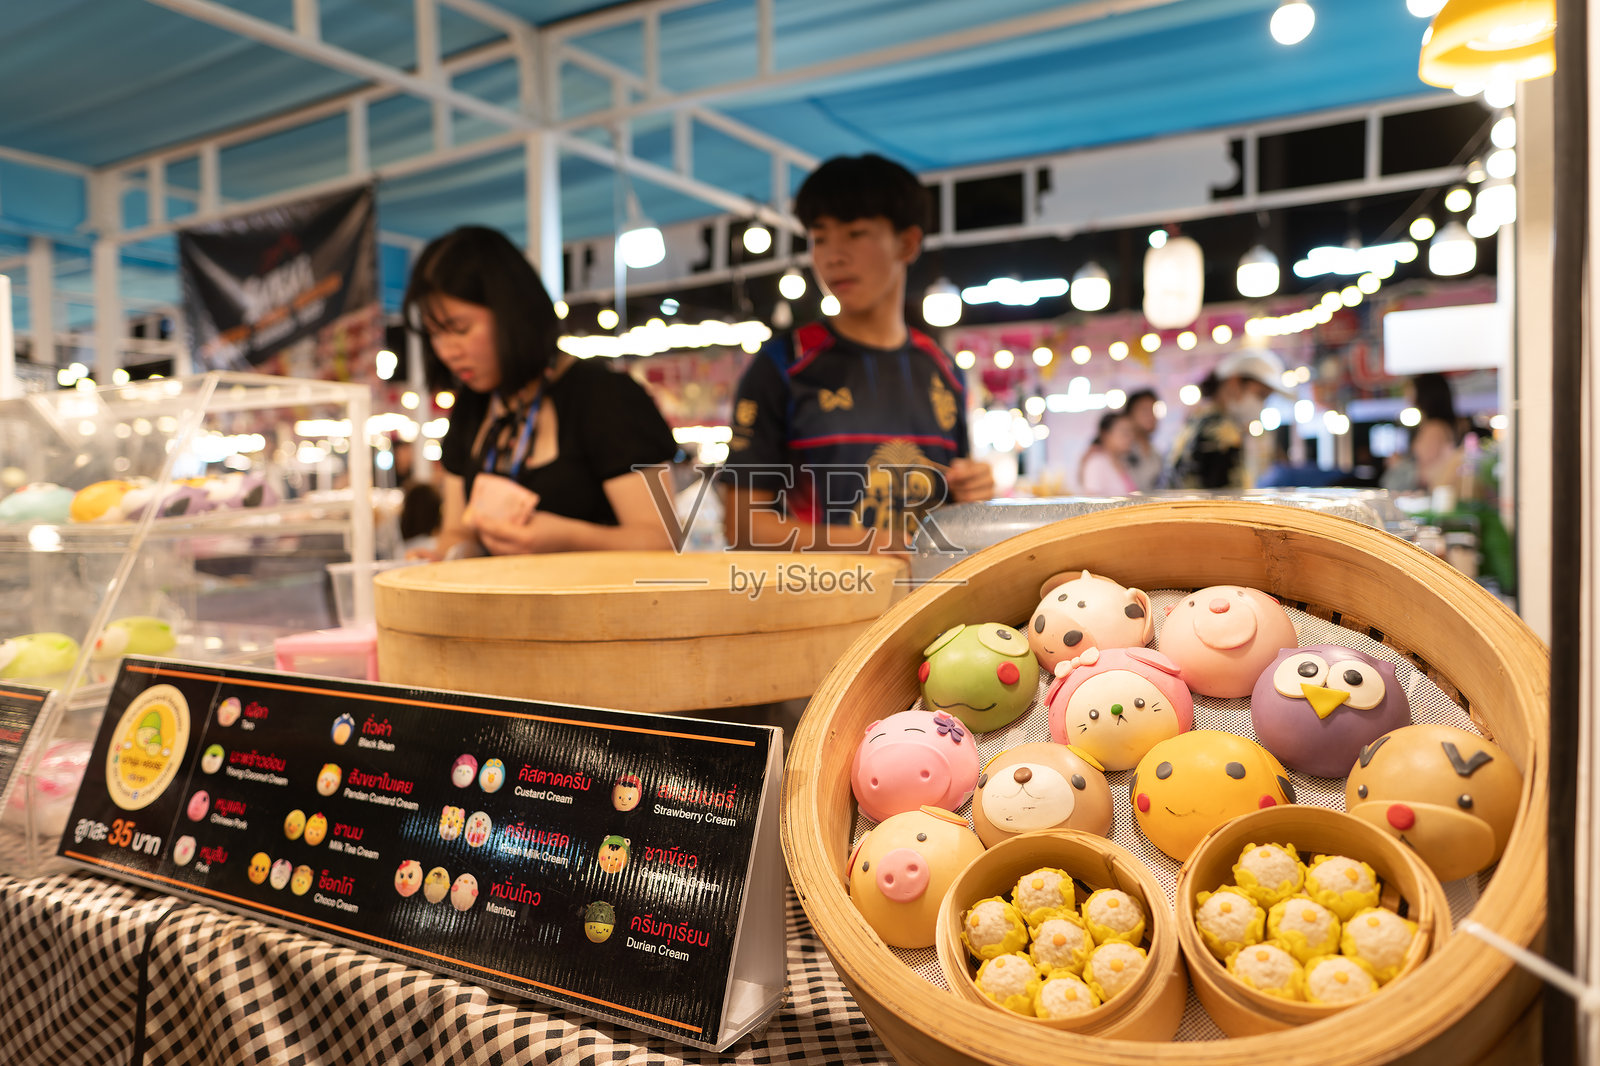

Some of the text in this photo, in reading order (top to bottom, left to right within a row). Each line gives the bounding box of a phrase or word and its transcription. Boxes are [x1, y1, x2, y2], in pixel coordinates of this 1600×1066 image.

[362, 713, 392, 737] ถั่วดำ
[358, 736, 395, 752] Black Bean
[229, 749, 286, 772] มะพร้าวอ่อน
[226, 765, 288, 786] Young Coconut Cream
[348, 767, 414, 795] สังขยาใบเตย
[518, 763, 592, 791] คัสตาดครีม
[343, 787, 419, 811] Pandan Custard Cream
[514, 785, 573, 804] Custard Cream
[215, 798, 247, 816] หมูแดง
[653, 803, 736, 827] Strawberry Cream
[233, 818, 248, 831] Pork
[333, 822, 364, 840] ชานม
[505, 821, 569, 848] ครีมนมสด
[75, 818, 162, 856] ลูกละ 35 บาท
[328, 839, 379, 860] Milk Tea Cream
[500, 843, 568, 866] Fresh Milk Cream
[645, 846, 698, 870] ชาเขียว
[319, 869, 356, 896] ช็อกโก้
[641, 867, 668, 881] Green
[490, 875, 541, 906] หมั่นโถว
[313, 892, 359, 913] Choco Cream
[486, 902, 516, 918] Mantou
[630, 913, 710, 947] ครีมทุเรียน
[626, 936, 690, 961] Durian Cream
